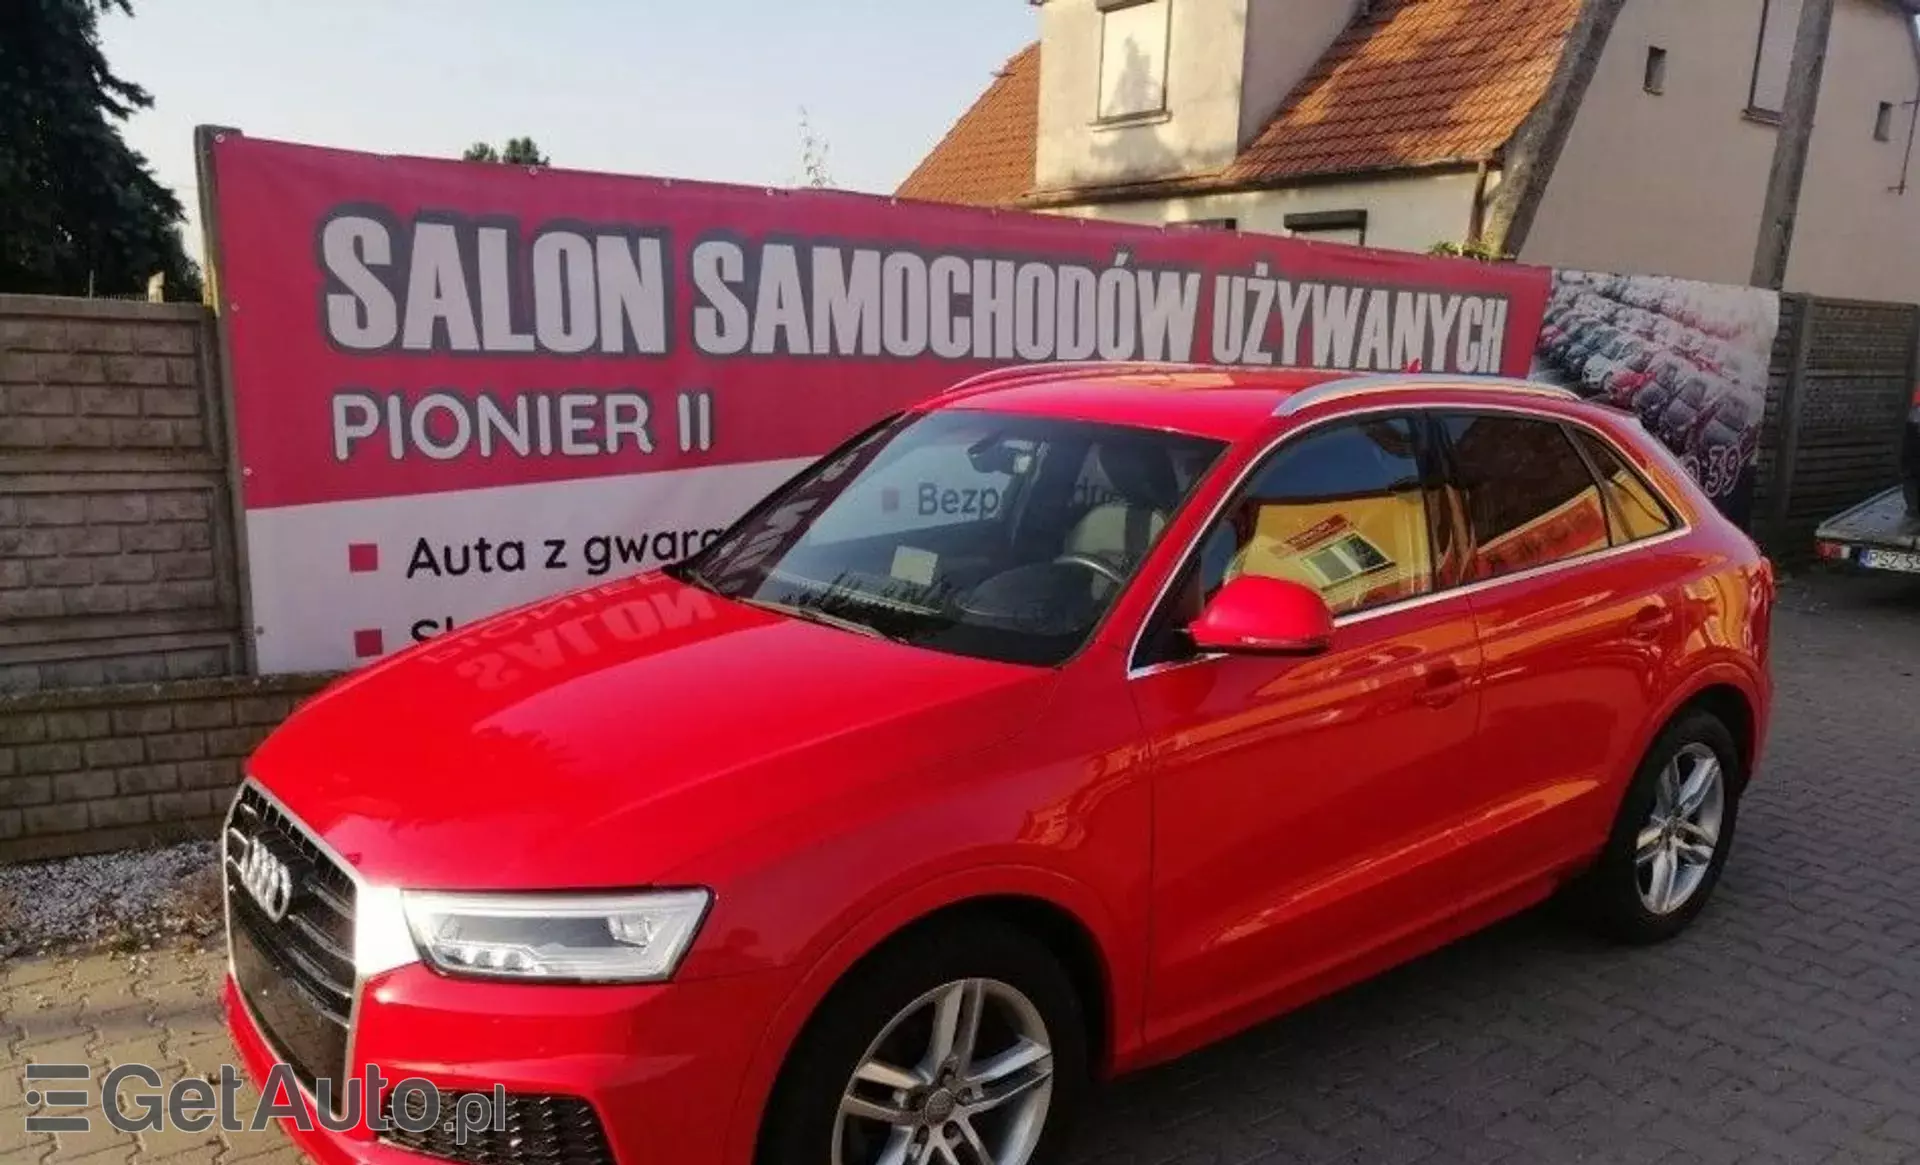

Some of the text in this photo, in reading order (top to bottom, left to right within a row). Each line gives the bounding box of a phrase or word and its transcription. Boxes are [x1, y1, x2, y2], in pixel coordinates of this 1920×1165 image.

[321, 213, 1510, 374] SALON SAMOCHODÓW UŻYWANYCH
[332, 391, 712, 461] PIONIER II
[406, 536, 526, 580] Auta
[543, 538, 568, 569] z
